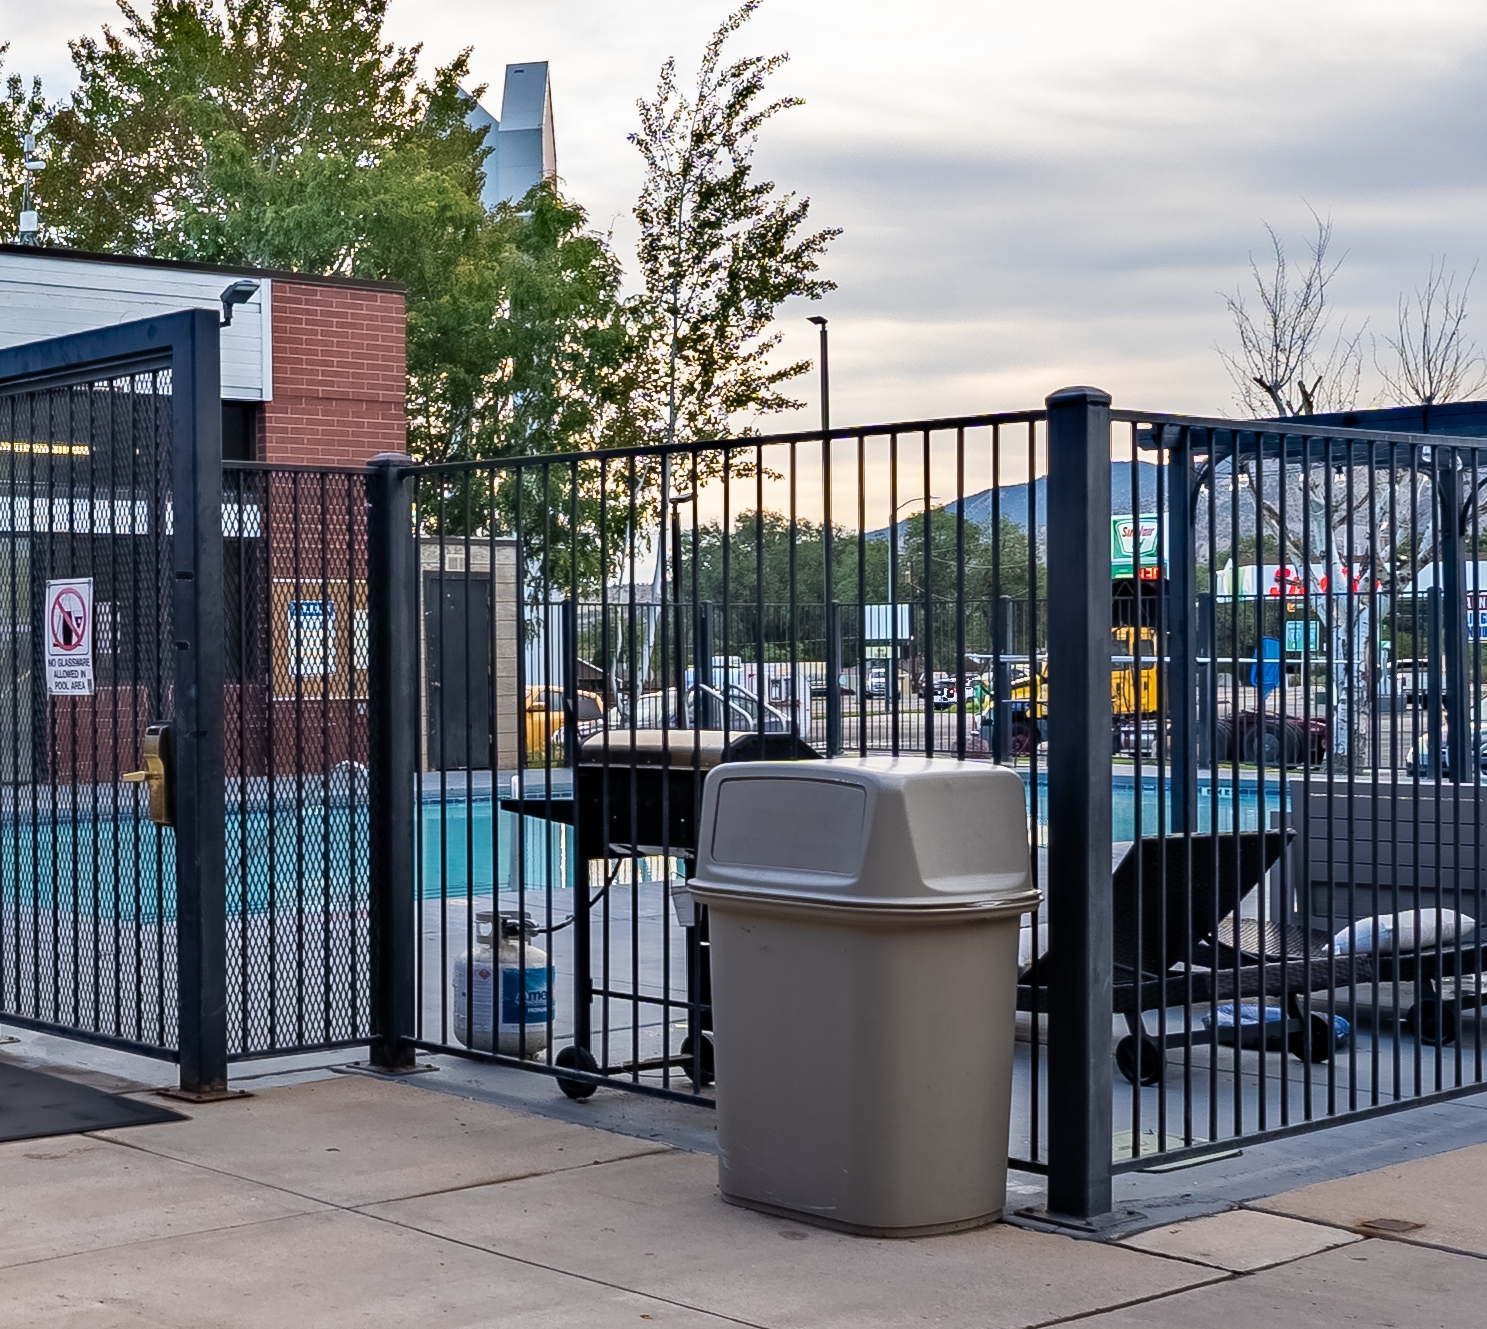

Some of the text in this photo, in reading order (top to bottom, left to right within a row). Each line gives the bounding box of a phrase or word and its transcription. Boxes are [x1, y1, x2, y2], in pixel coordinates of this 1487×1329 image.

[48, 658, 56, 667] NO
[54, 670, 86, 678] ALLOWED IN
[55, 681, 85, 690] POOL AREA
